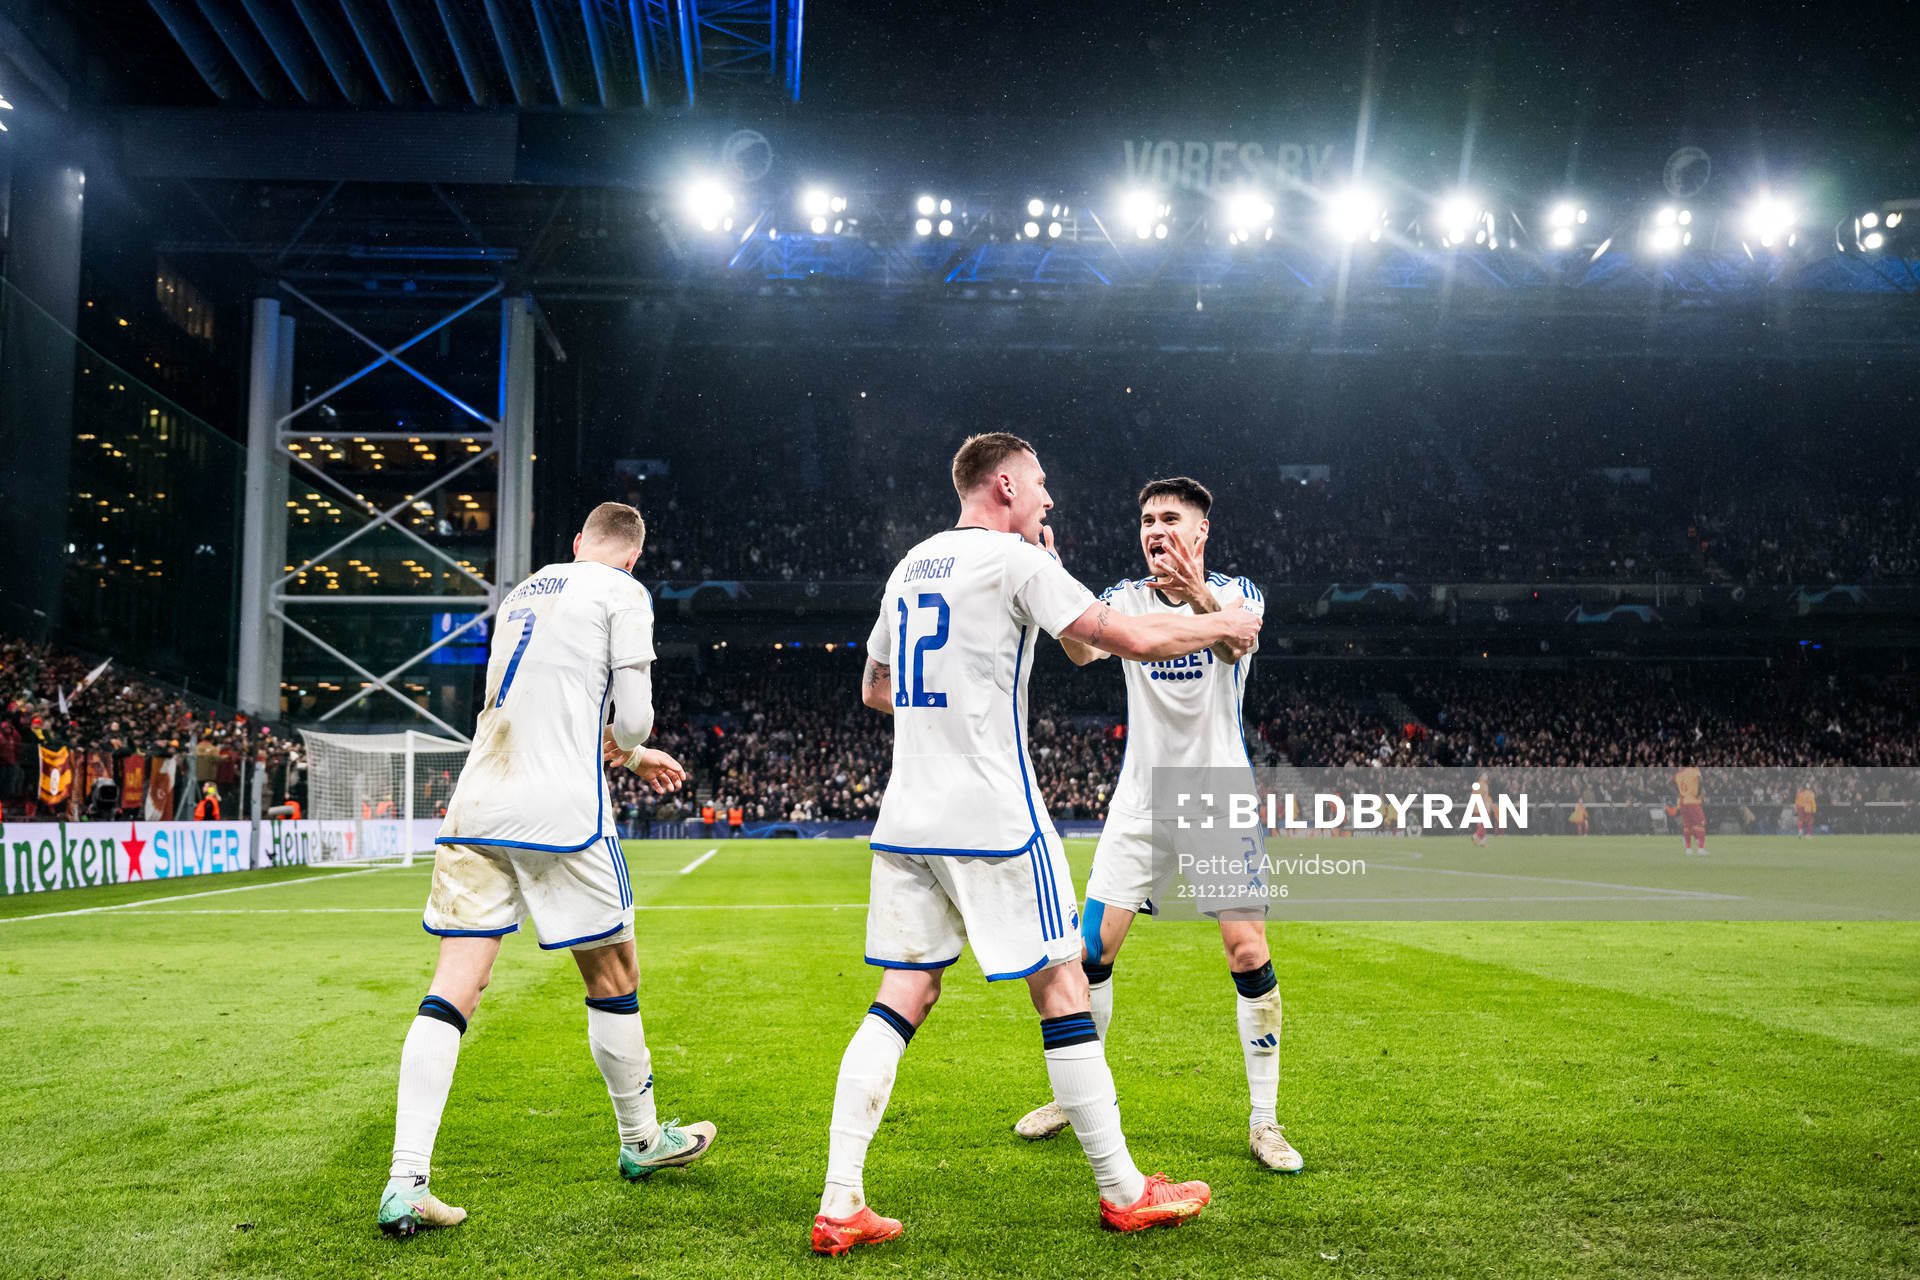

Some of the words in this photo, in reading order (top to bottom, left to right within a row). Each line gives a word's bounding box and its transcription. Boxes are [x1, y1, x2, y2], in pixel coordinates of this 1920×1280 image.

[1124, 140, 1264, 188] VORES
[1277, 143, 1334, 188] BY
[904, 556, 955, 583] LERAGER
[495, 607, 537, 708] 7
[896, 593, 950, 707] 12
[153, 828, 240, 879] SILVER
[1241, 836, 1258, 874] 2
